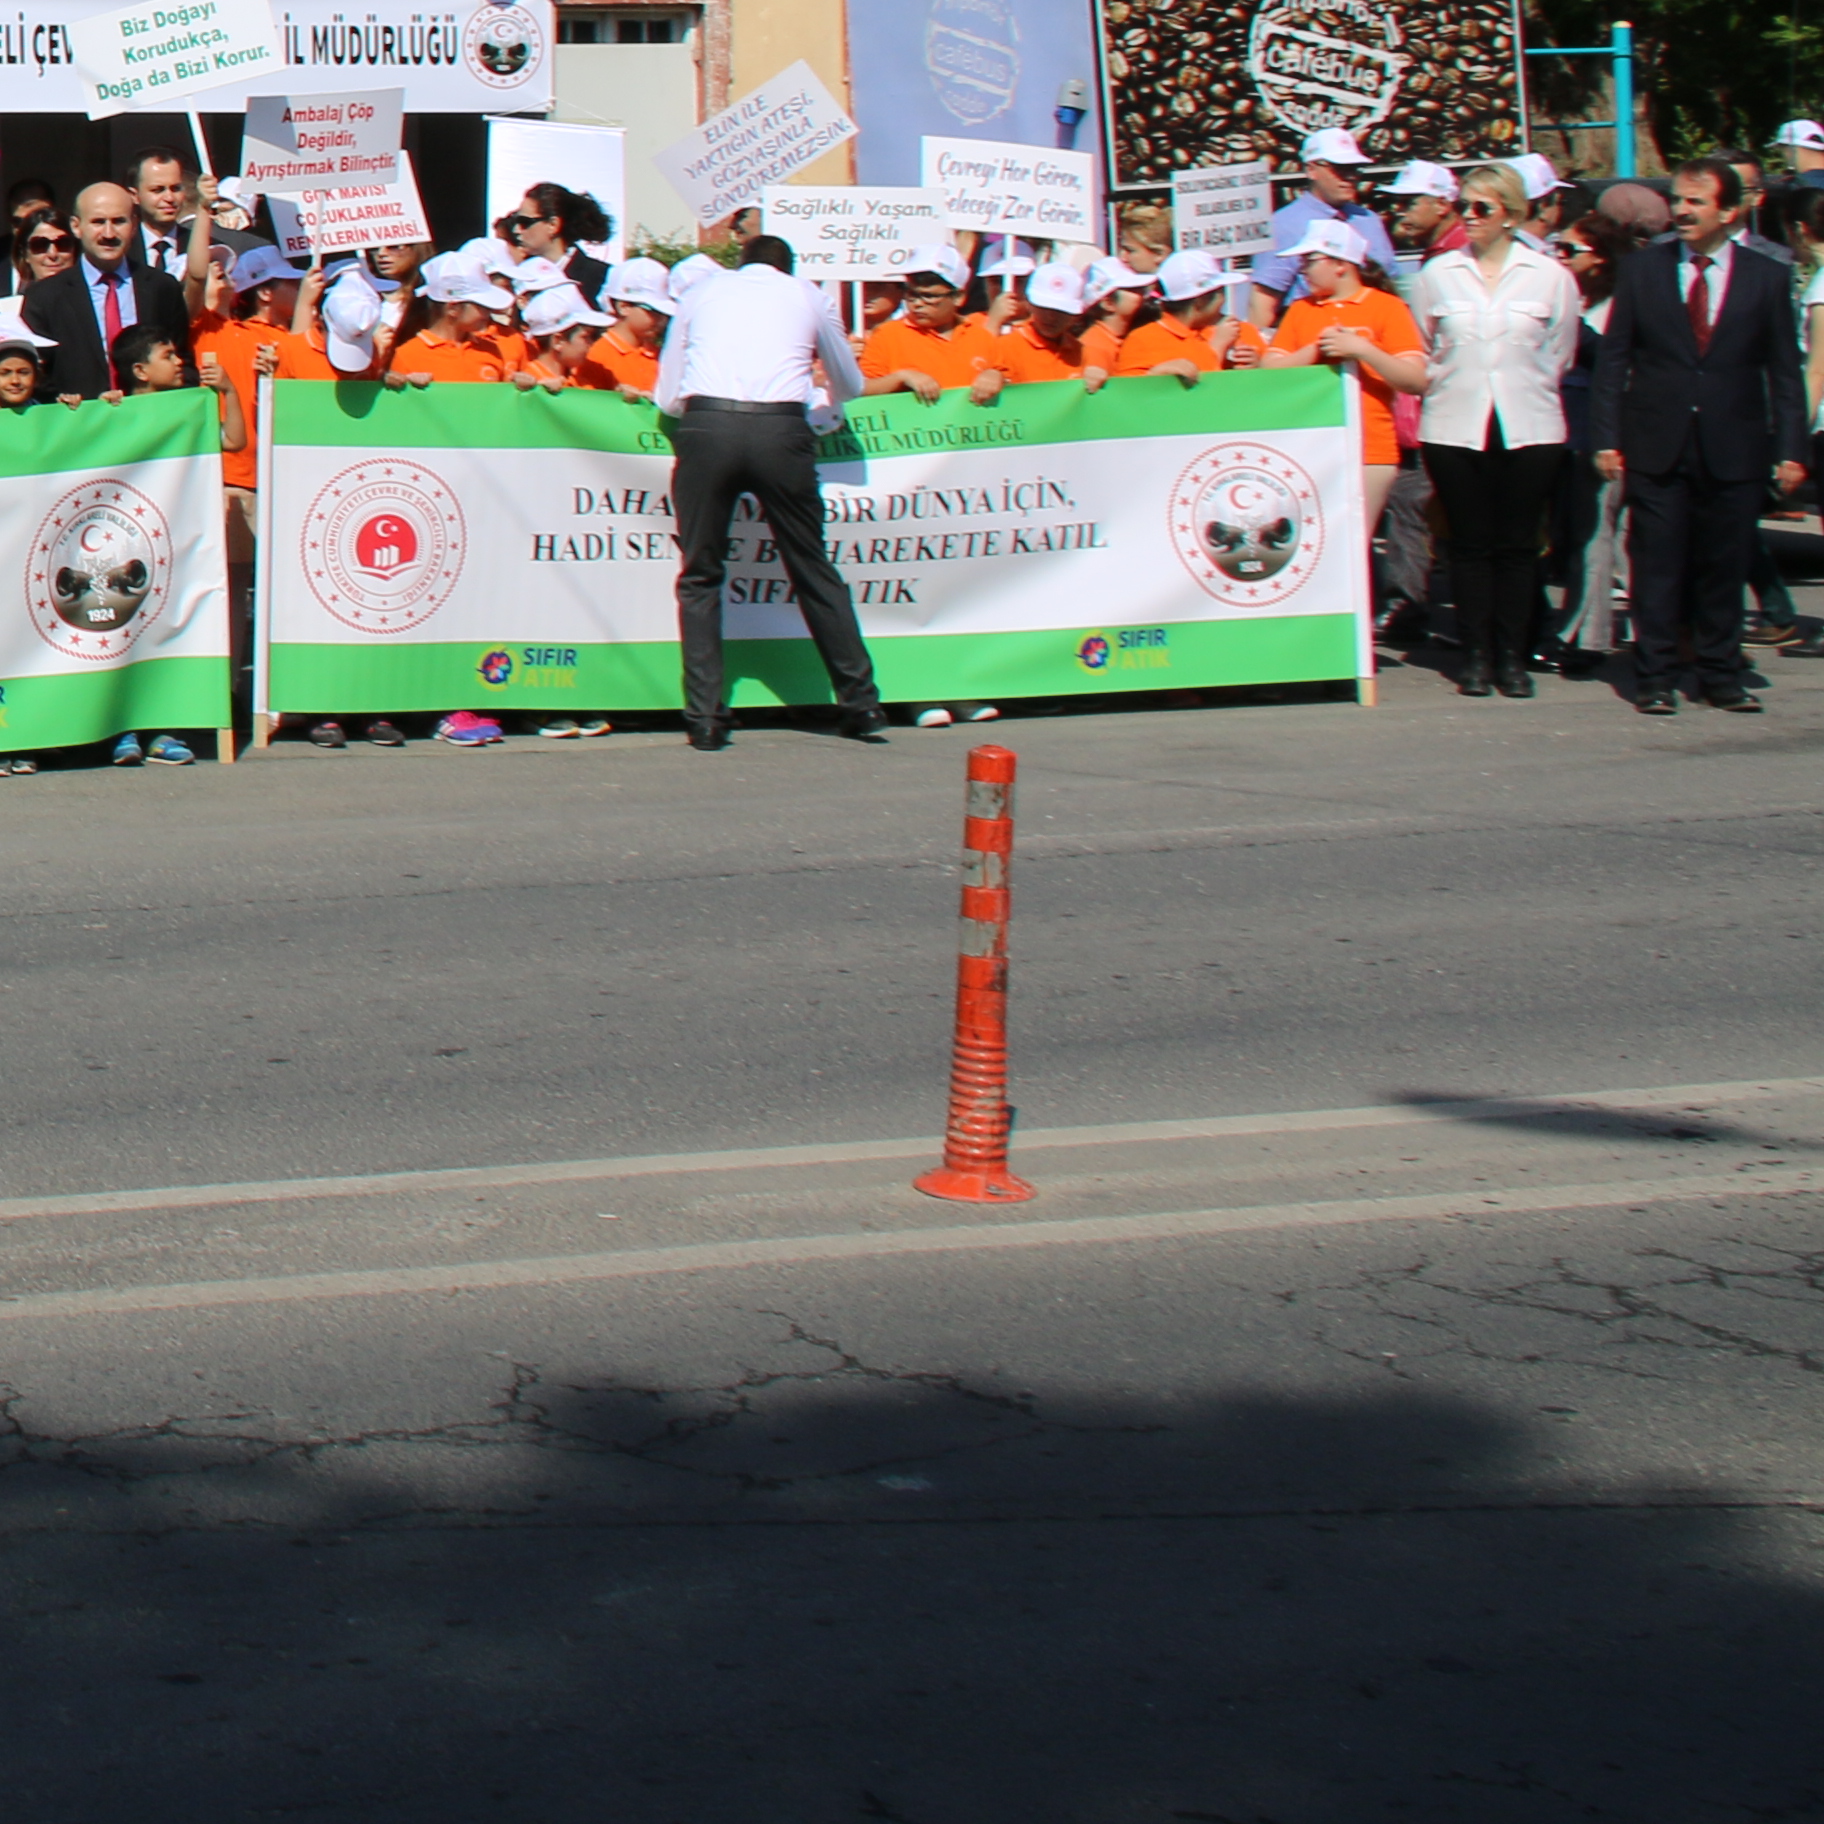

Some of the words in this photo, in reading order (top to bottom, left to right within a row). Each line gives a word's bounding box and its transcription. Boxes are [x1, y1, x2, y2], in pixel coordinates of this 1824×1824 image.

[118, 17, 151, 38] Biz
[152, 0, 218, 31] Doğayı
[121, 26, 230, 66] Korudukça,
[284, 12, 306, 65] İL
[311, 13, 459, 66] MÜDÜRLÜĞÜ
[95, 76, 145, 101] Doğa
[147, 68, 172, 88] da
[173, 58, 210, 80] Bizi
[212, 44, 271, 71] Korur.
[281, 103, 344, 125] Ambalaj
[347, 102, 374, 124] Çöp
[702, 111, 741, 145] ELİN
[740, 93, 770, 121] İLE
[296, 130, 357, 152] Değildir,
[682, 125, 760, 180] YAKTIĞIN
[711, 115, 815, 189] GÖZYAŞINLA
[245, 157, 335, 182] Ayrıştırmak
[338, 153, 397, 175] Bilinçtir.
[700, 118, 852, 219] SÖNDÜREMEZSİN.
[936, 151, 1000, 188] Çevreyi
[999, 157, 1031, 182] Hor
[1033, 160, 1083, 192] Gören,
[771, 198, 854, 220] Sağlıklı
[944, 187, 1002, 226] eleceği
[1001, 194, 1035, 220] Zor
[1036, 197, 1085, 226] Görür.
[372, 219, 424, 240] VARİSİ.
[818, 223, 901, 245] Sağlıklı
[1180, 227, 1201, 250] BİR
[1203, 223, 1234, 250] AĞAÇ
[893, 419, 1024, 450] MÜDÜRLÜĞÜ
[363, 486, 399, 500] ÇEVRE
[571, 486, 675, 517] DAHA
[822, 491, 878, 524] BİR
[884, 484, 996, 521] DÜNYA
[1000, 474, 1077, 519] İÇİN,
[529, 526, 618, 562] HADİ
[823, 529, 1002, 565] HAREKETE
[1007, 521, 1109, 556] KATIL
[87, 607, 116, 623] 1924
[1118, 628, 1168, 648] SIFIR
[522, 647, 577, 667] SIFIR
[1120, 648, 1172, 670] ATIK
[523, 668, 578, 688] ATIK
